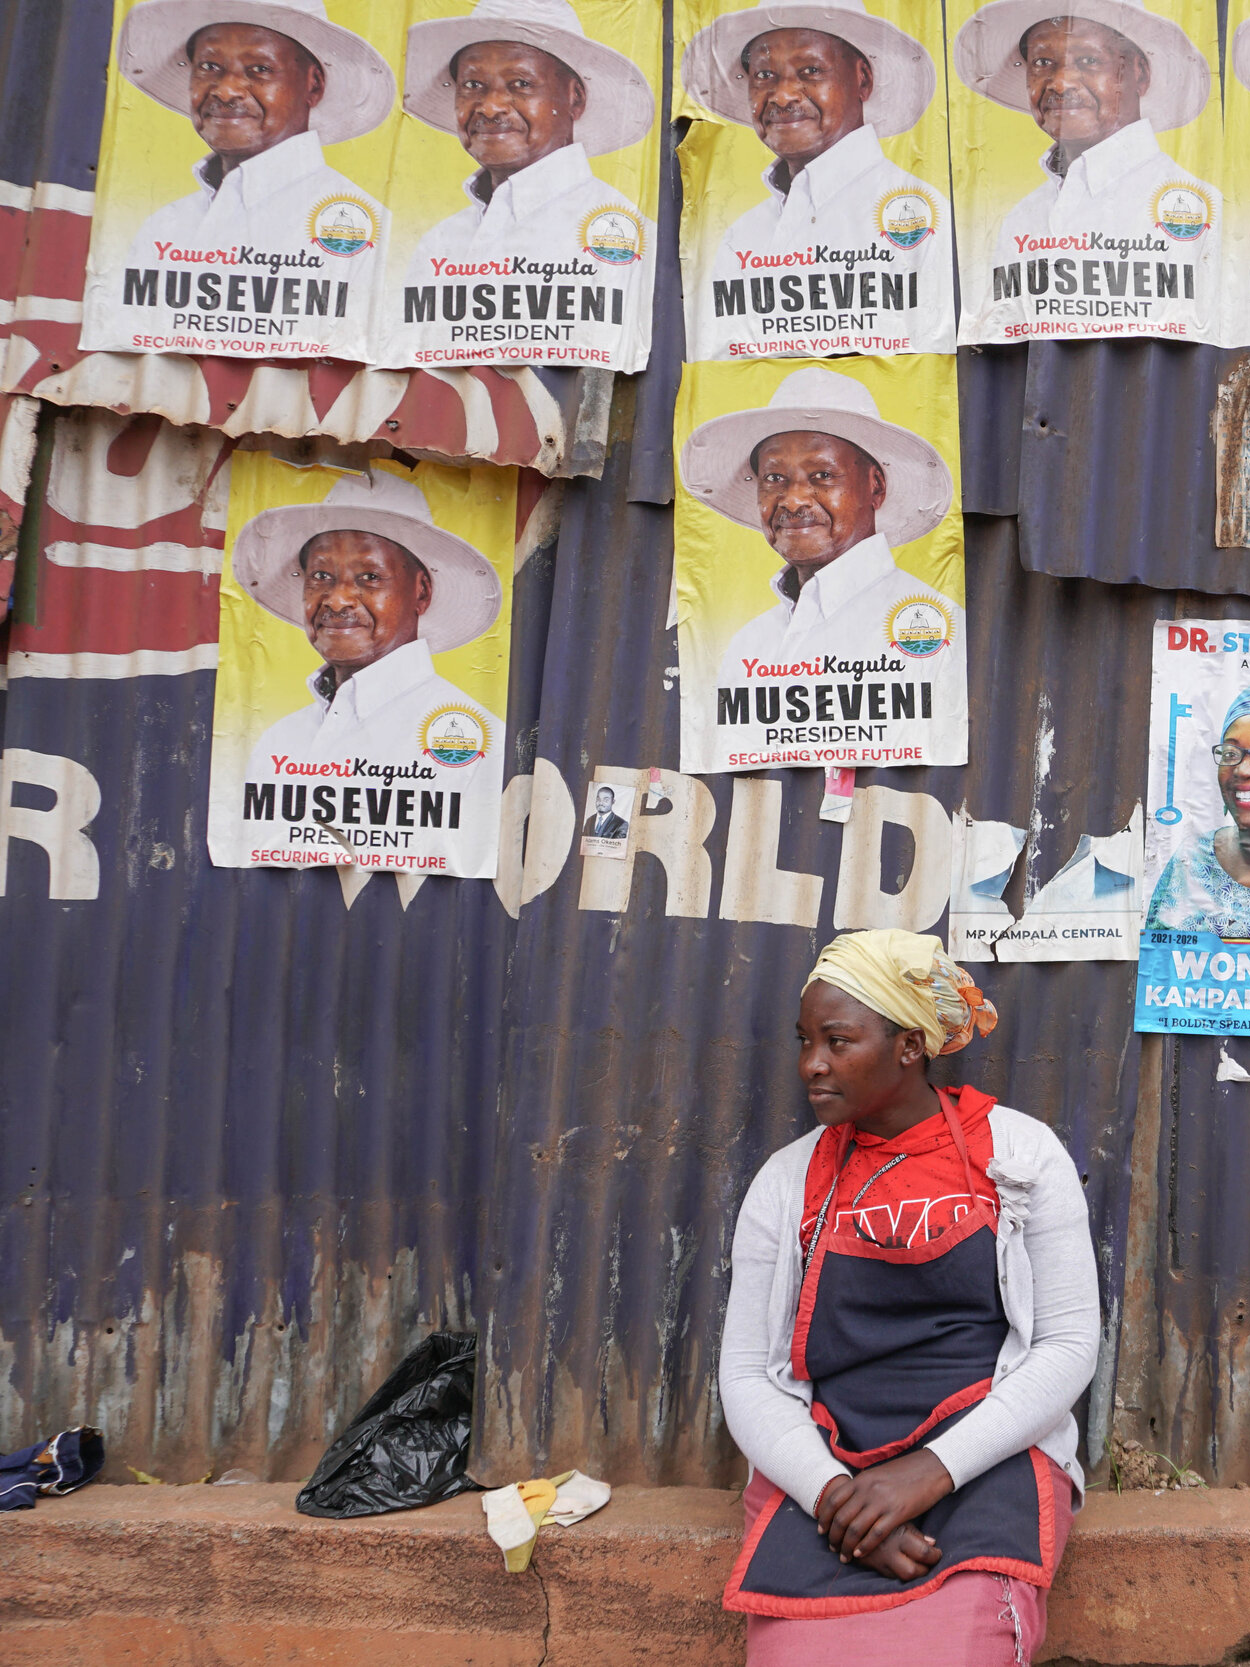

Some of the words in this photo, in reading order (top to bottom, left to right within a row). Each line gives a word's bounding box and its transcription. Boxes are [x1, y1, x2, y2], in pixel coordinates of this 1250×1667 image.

[993, 257, 1195, 302] MUSEVENI
[123, 268, 349, 318] MUSEVENI
[713, 271, 918, 318] MUSEVENI
[404, 284, 624, 325] MUSEVENI
[1035, 299, 1152, 318] PRESIDENT
[173, 313, 298, 336] PRESIDENT
[451, 324, 575, 342] PRESIDENT
[762, 313, 878, 335] PRESIDENT
[1004, 322, 1079, 338] SECURING
[1081, 322, 1124, 333] YOUR
[1128, 323, 1187, 335] FUTURE
[132, 334, 215, 351] SECURING
[219, 339, 265, 353] YOUR
[271, 342, 330, 354] FUTURE
[729, 339, 807, 356] SECURING
[809, 336, 850, 351] YOUR
[854, 337, 910, 350] FUTURE
[414, 347, 495, 363] SECURING
[498, 347, 543, 360] YOUR
[548, 347, 610, 363] FUTURE
[1167, 625, 1217, 653] DR.
[1240, 660, 1249, 669] A
[717, 682, 932, 725] MUSEVENI
[765, 724, 887, 746] PRESIDENT
[728, 749, 811, 766] SECURING
[813, 748, 857, 761] YOUR
[862, 747, 923, 761] FUTURE
[243, 782, 462, 830] MUSEVENI
[250, 849, 331, 864] SECURING
[385, 855, 447, 869] FUTURE
[966, 929, 986, 940] MP
[990, 929, 1058, 940] KAMPALA
[1061, 928, 1123, 939] CENTRAL
[1171, 1018, 1216, 1030] BOLDLY
